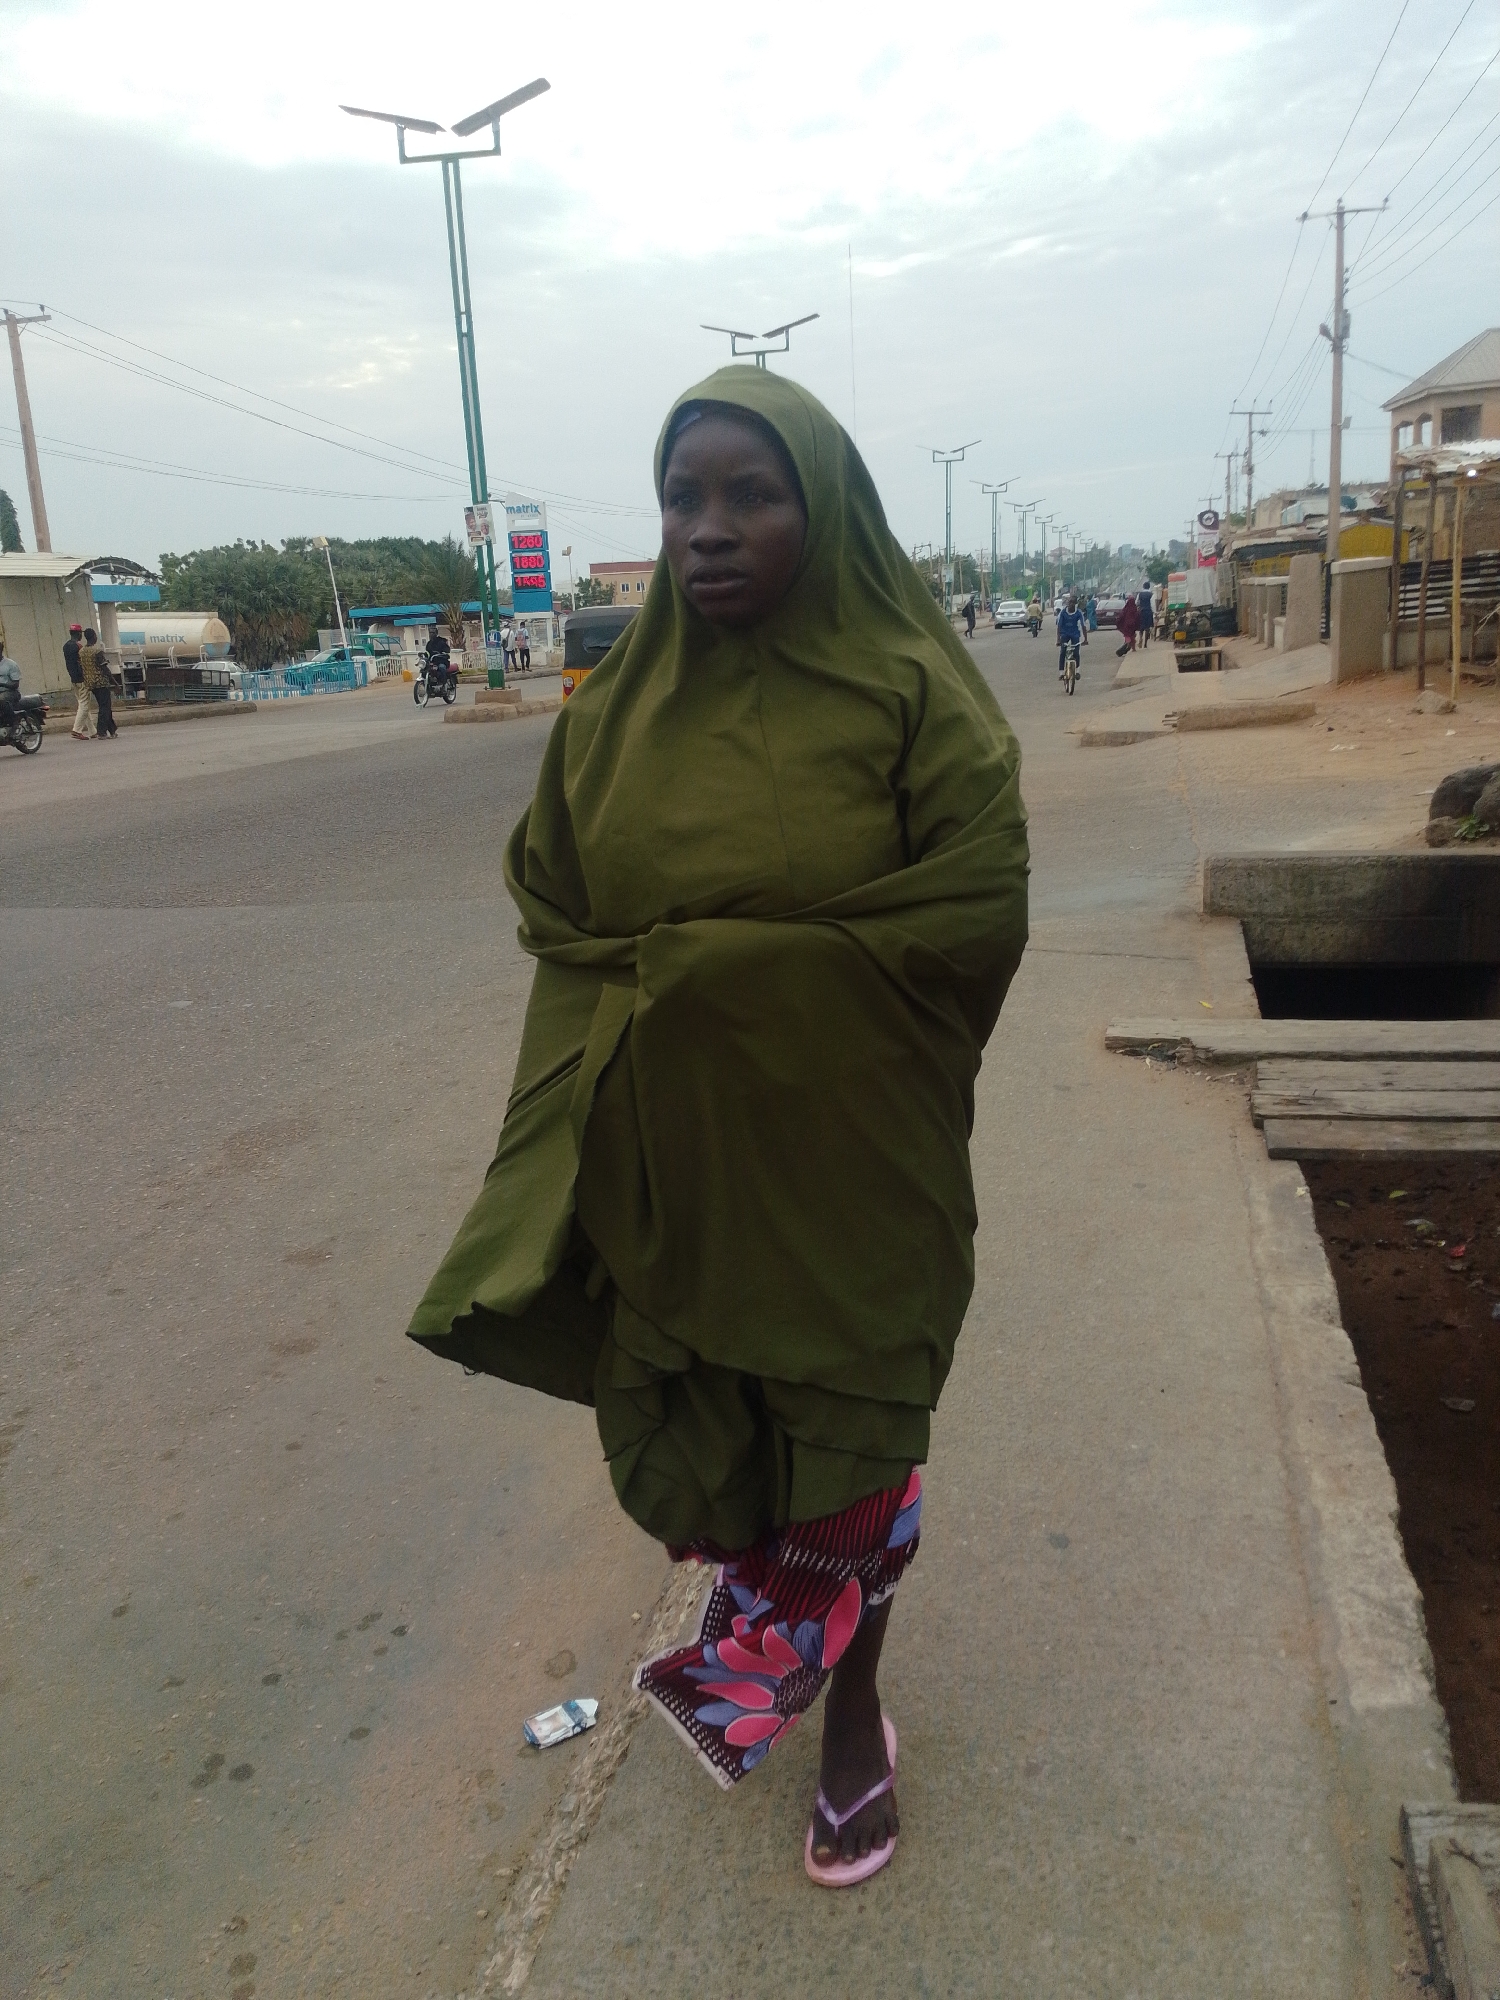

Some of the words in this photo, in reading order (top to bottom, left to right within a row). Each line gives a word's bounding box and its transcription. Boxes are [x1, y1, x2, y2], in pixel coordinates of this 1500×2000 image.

[506, 503, 541, 515] matrix
[512, 535, 543, 549] 1260
[150, 634, 187, 645] matrix
